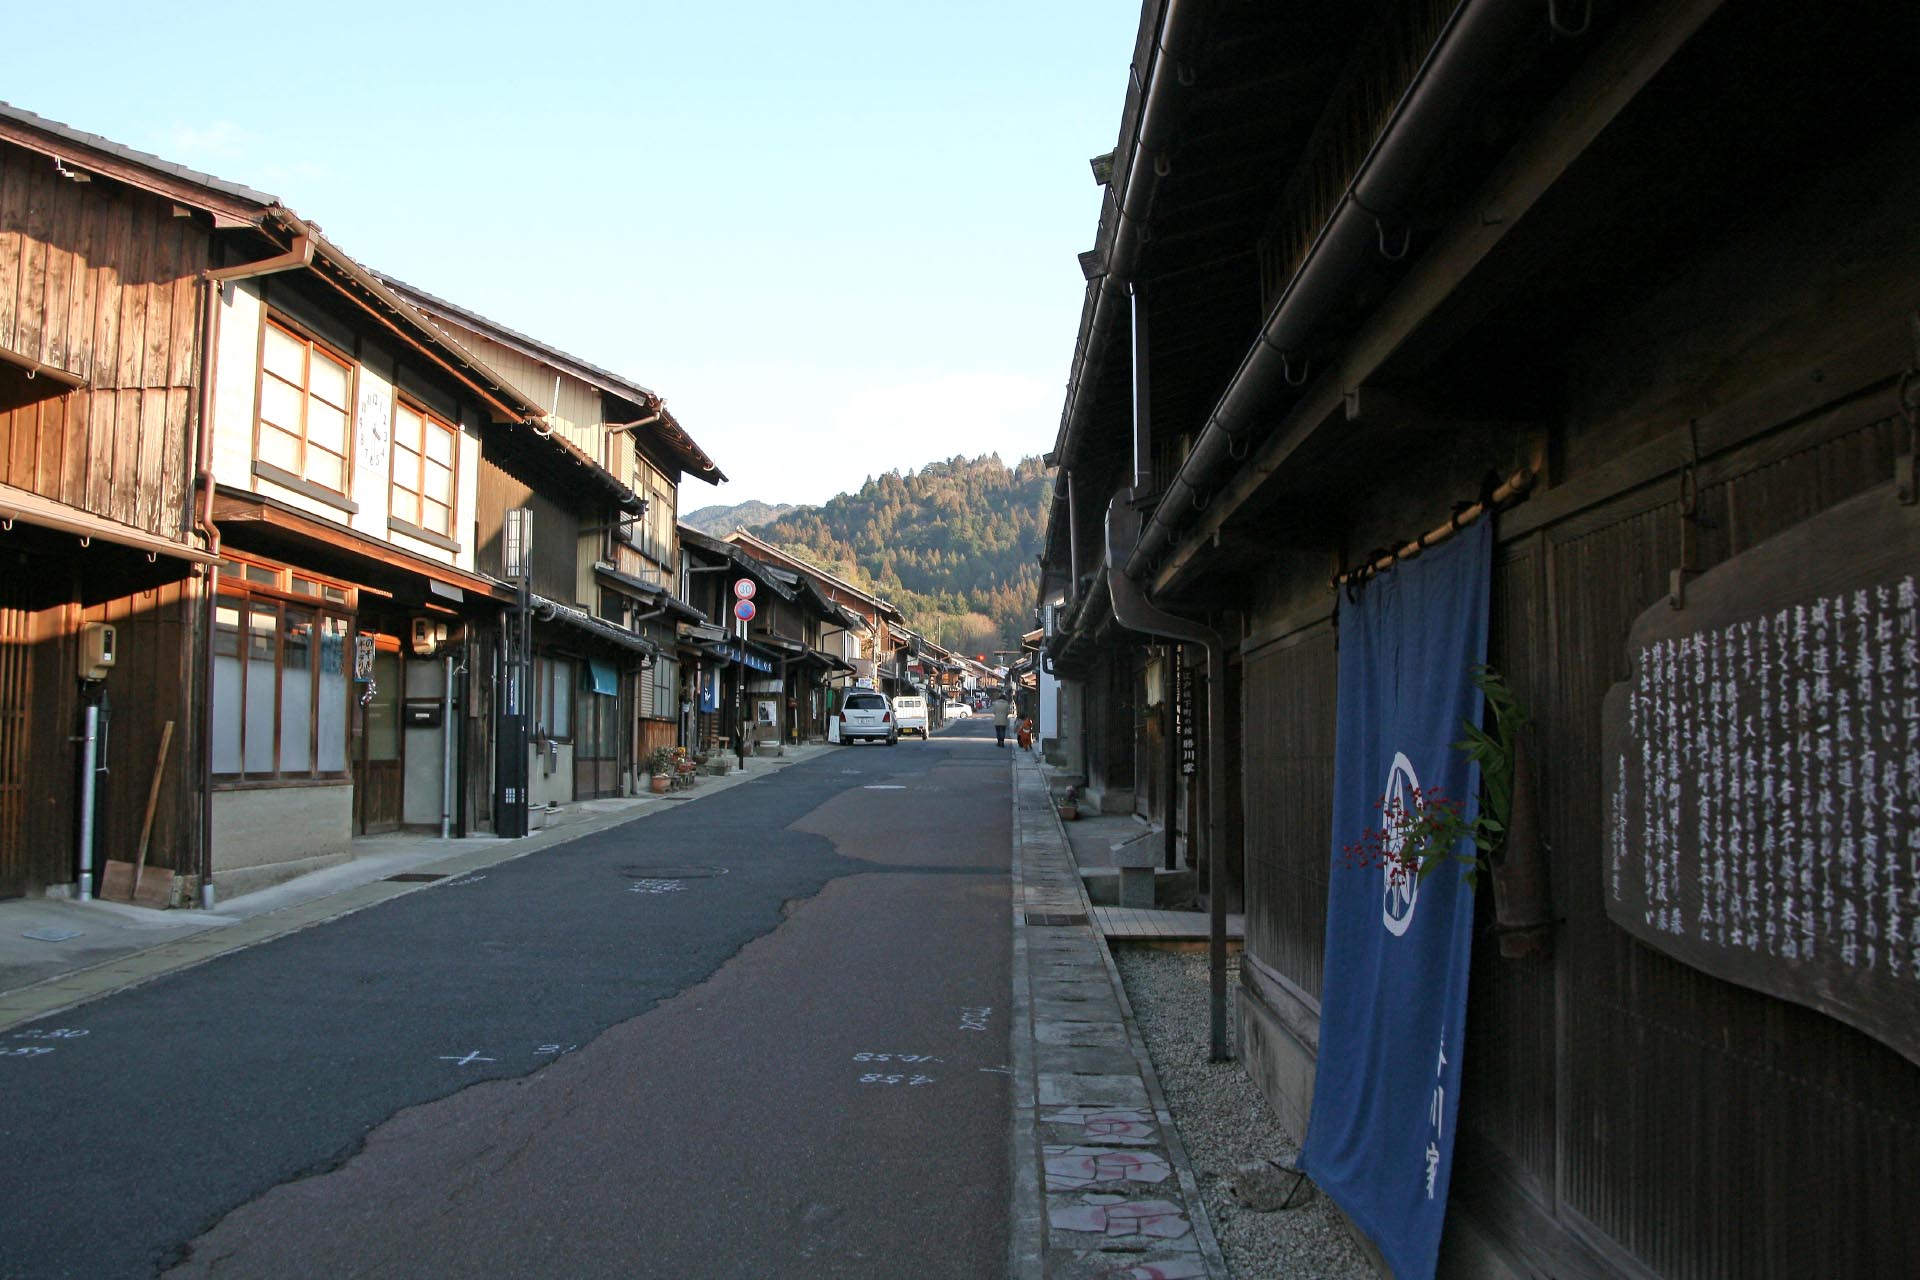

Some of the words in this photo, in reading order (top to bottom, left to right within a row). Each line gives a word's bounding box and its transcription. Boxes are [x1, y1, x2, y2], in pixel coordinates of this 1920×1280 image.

[740, 584, 752, 594] 30
[1182, 738, 1196, 773] 勝川家
